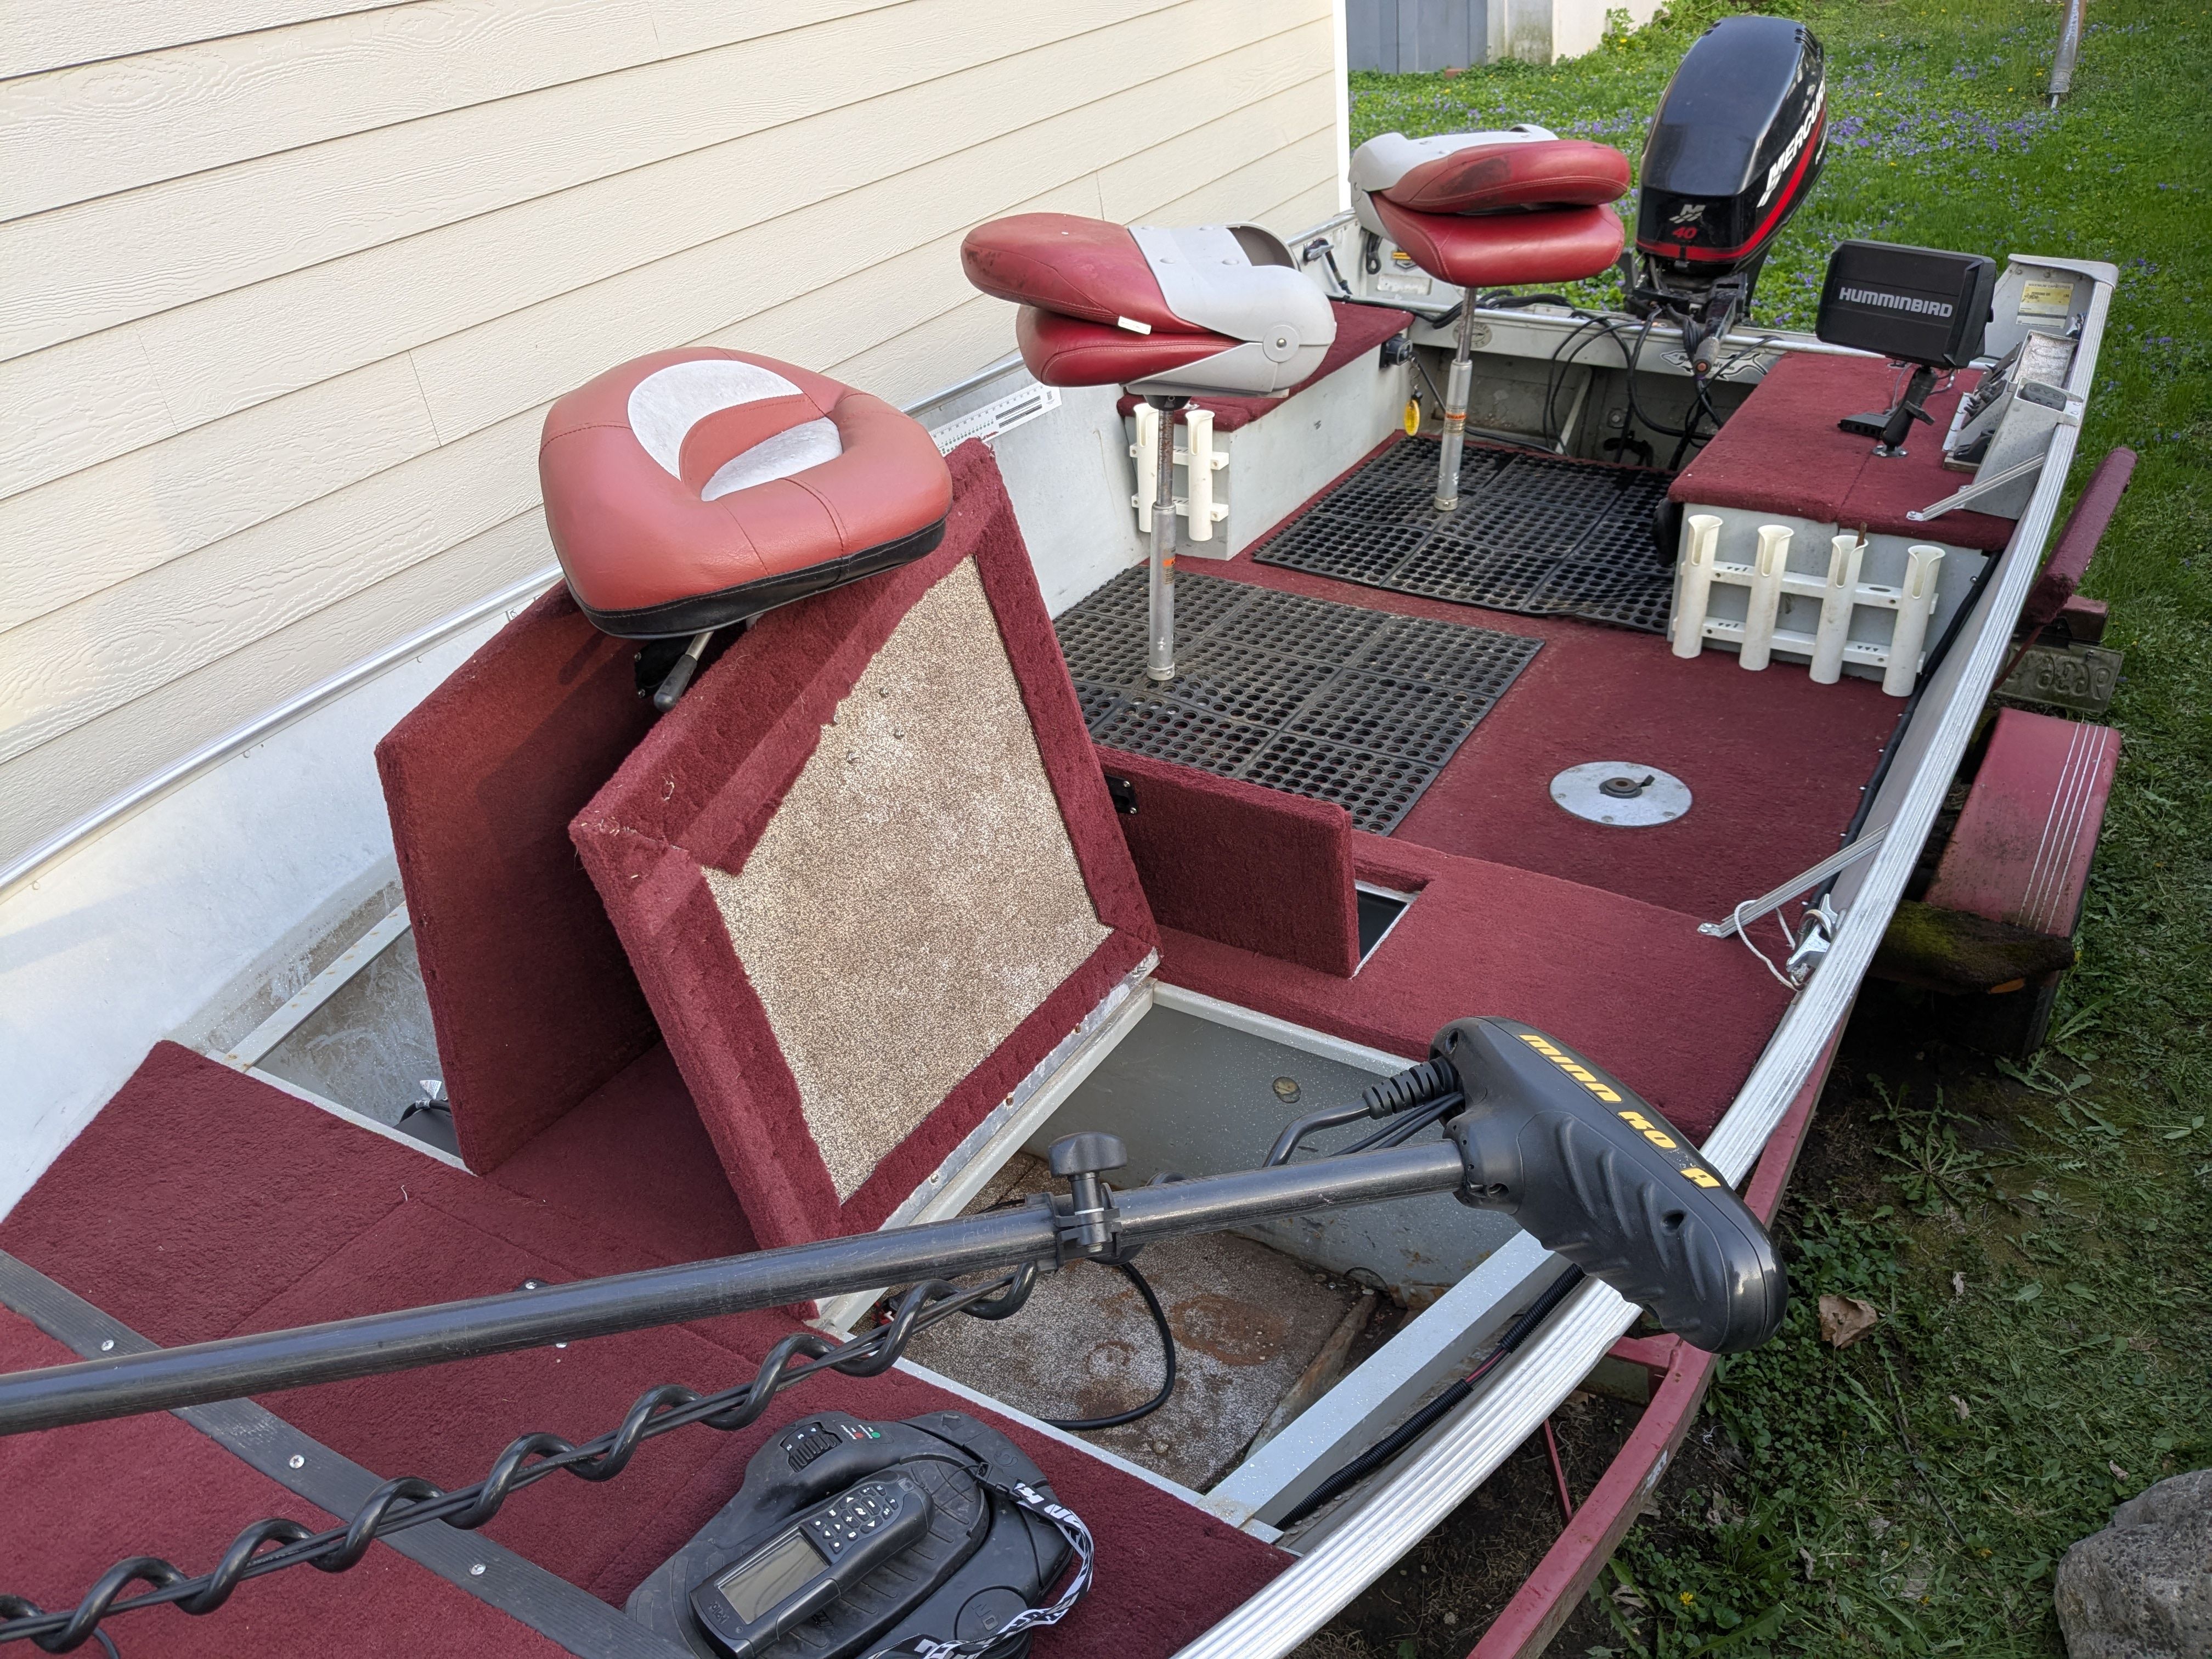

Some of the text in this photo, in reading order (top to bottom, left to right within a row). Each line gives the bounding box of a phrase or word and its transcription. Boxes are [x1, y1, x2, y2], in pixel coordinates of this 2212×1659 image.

[1757, 78, 1826, 208] MERCUR
[1672, 226, 1697, 239] 40
[1838, 287, 1953, 318] HUMMINBIRD
[1617, 1110, 1722, 1188] KOA
